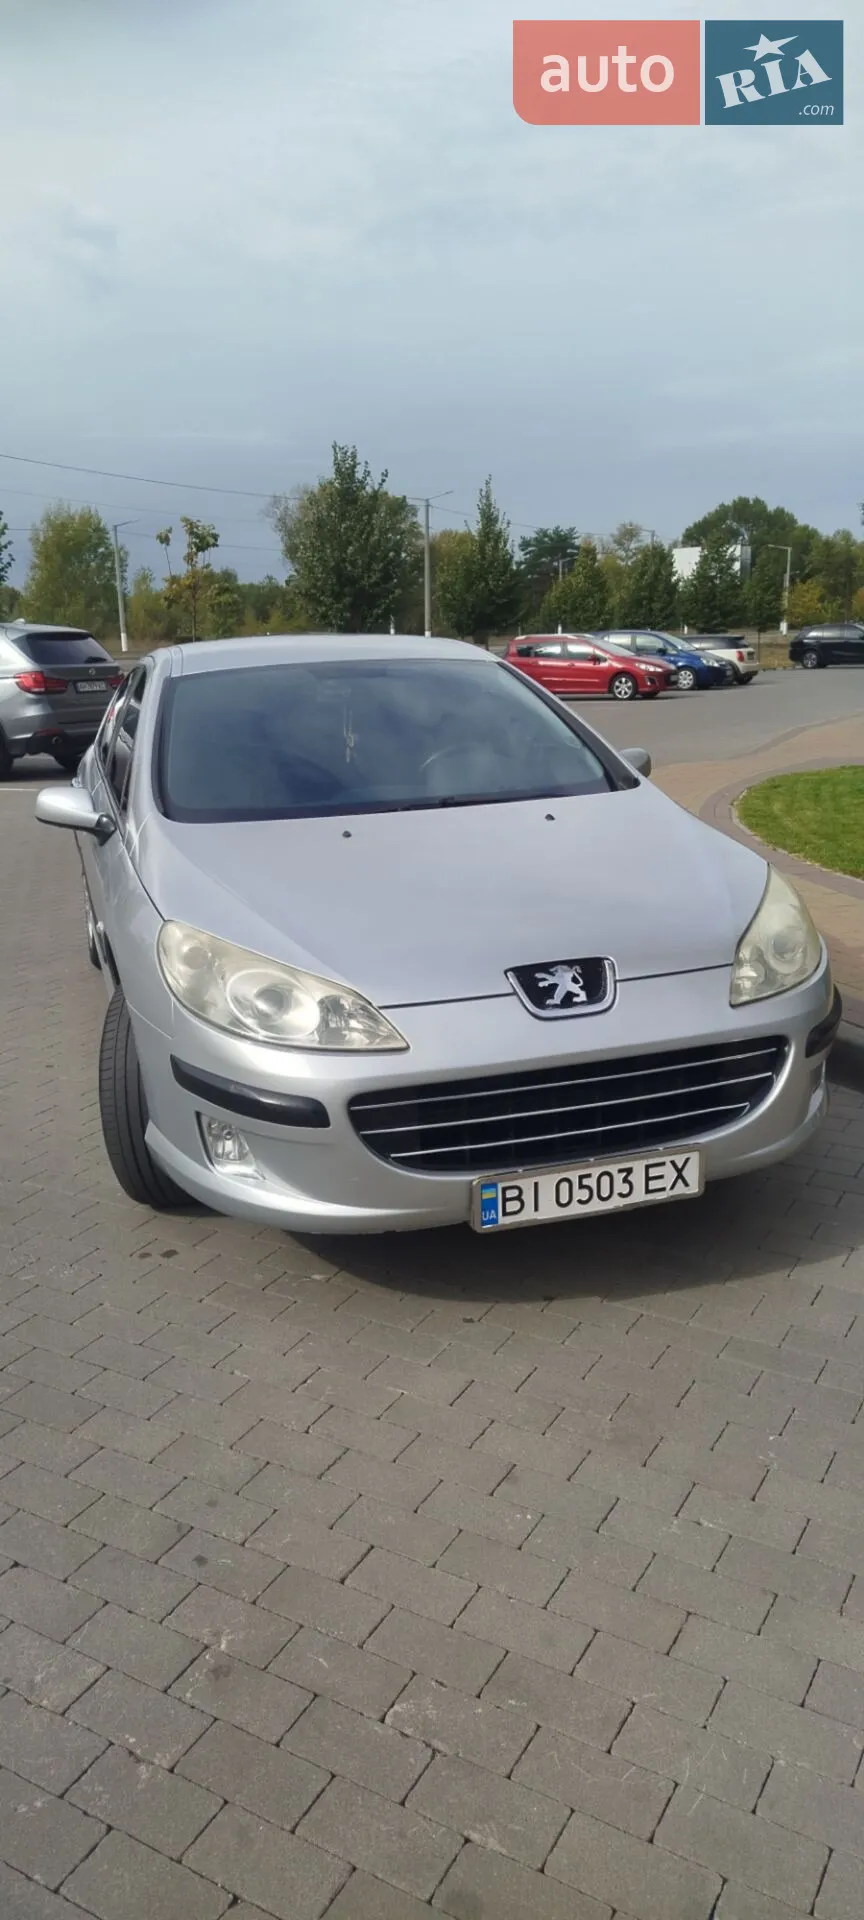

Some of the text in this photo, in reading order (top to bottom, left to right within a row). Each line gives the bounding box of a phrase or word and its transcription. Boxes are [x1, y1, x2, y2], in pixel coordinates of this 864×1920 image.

[501, 1156, 691, 1217] BI 0503 EX
[481, 1210, 497, 1221] UA
